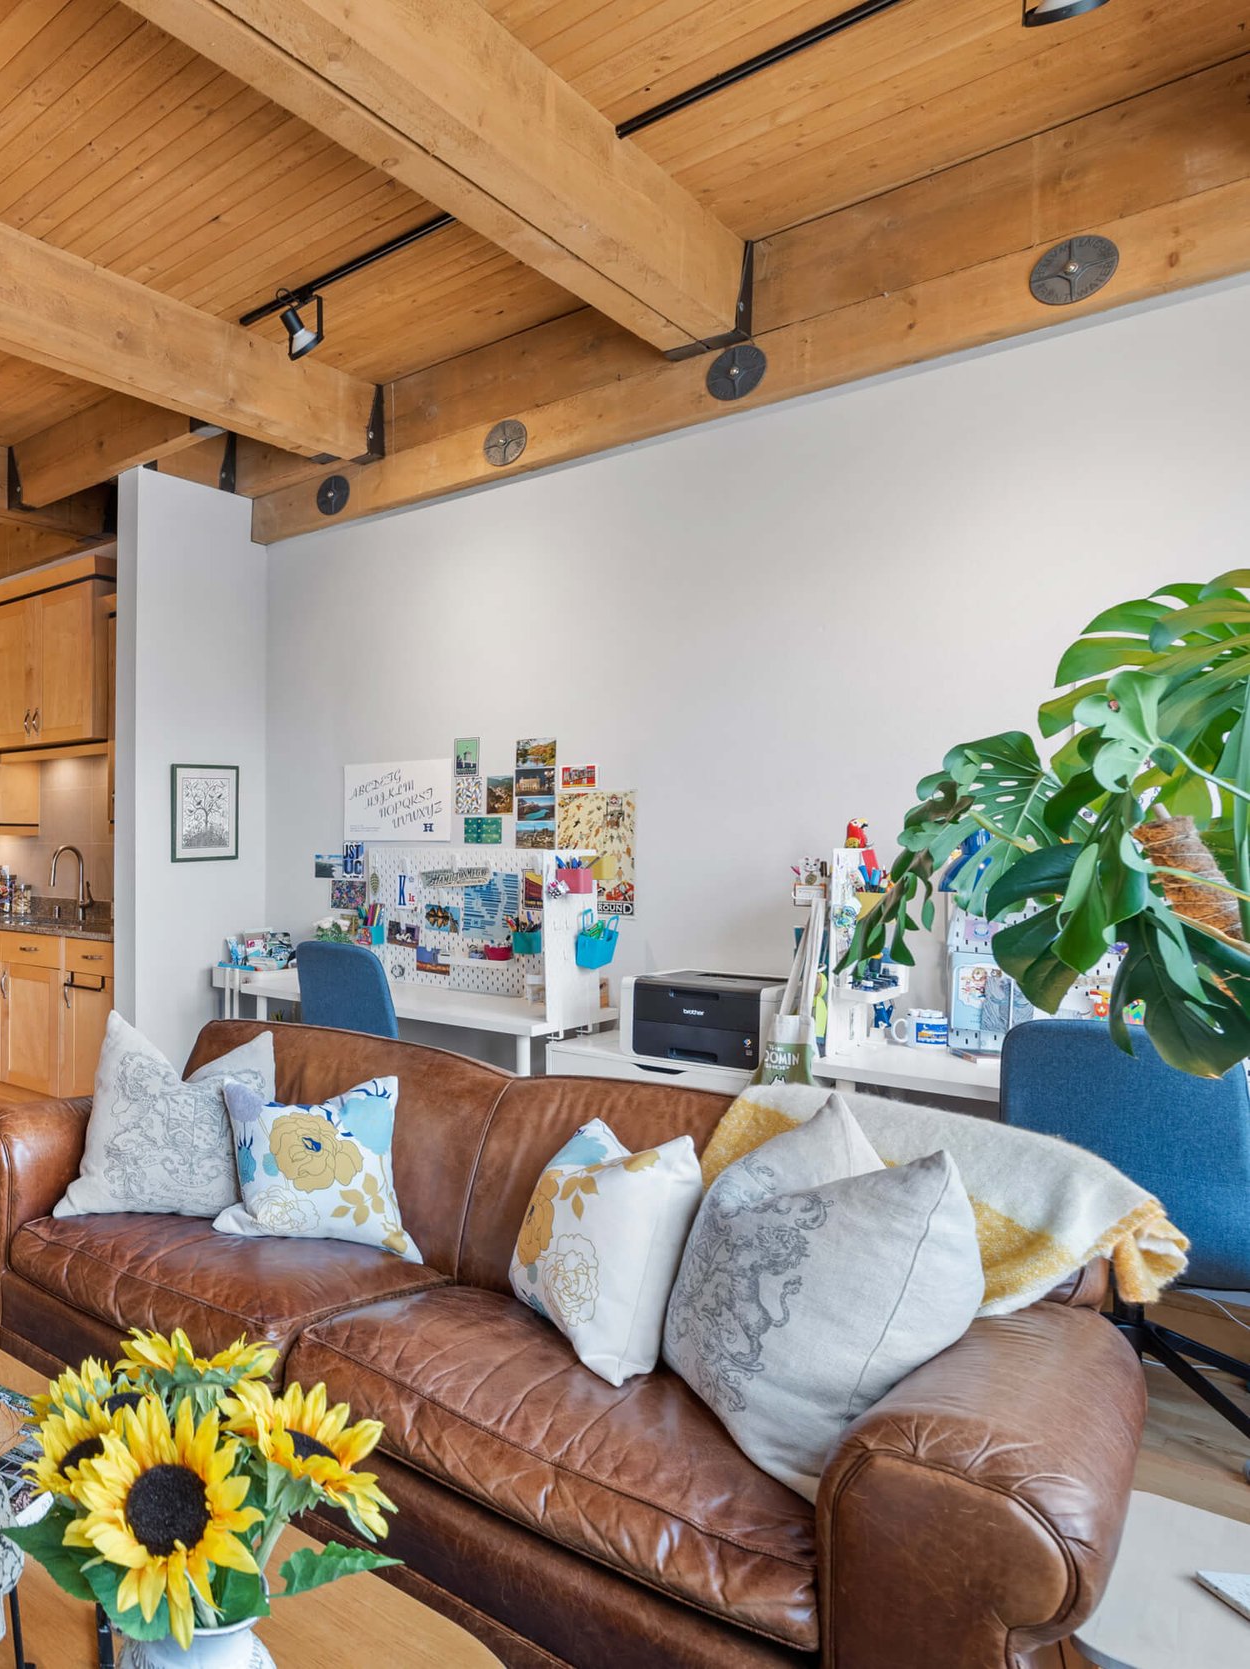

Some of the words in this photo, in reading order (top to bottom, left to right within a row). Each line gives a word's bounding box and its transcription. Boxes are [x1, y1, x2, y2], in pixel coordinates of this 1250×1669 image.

[422, 822, 434, 832] H
[398, 875, 406, 905] K
[598, 903, 633, 914] ROUND
[682, 1008, 705, 1016] brother
